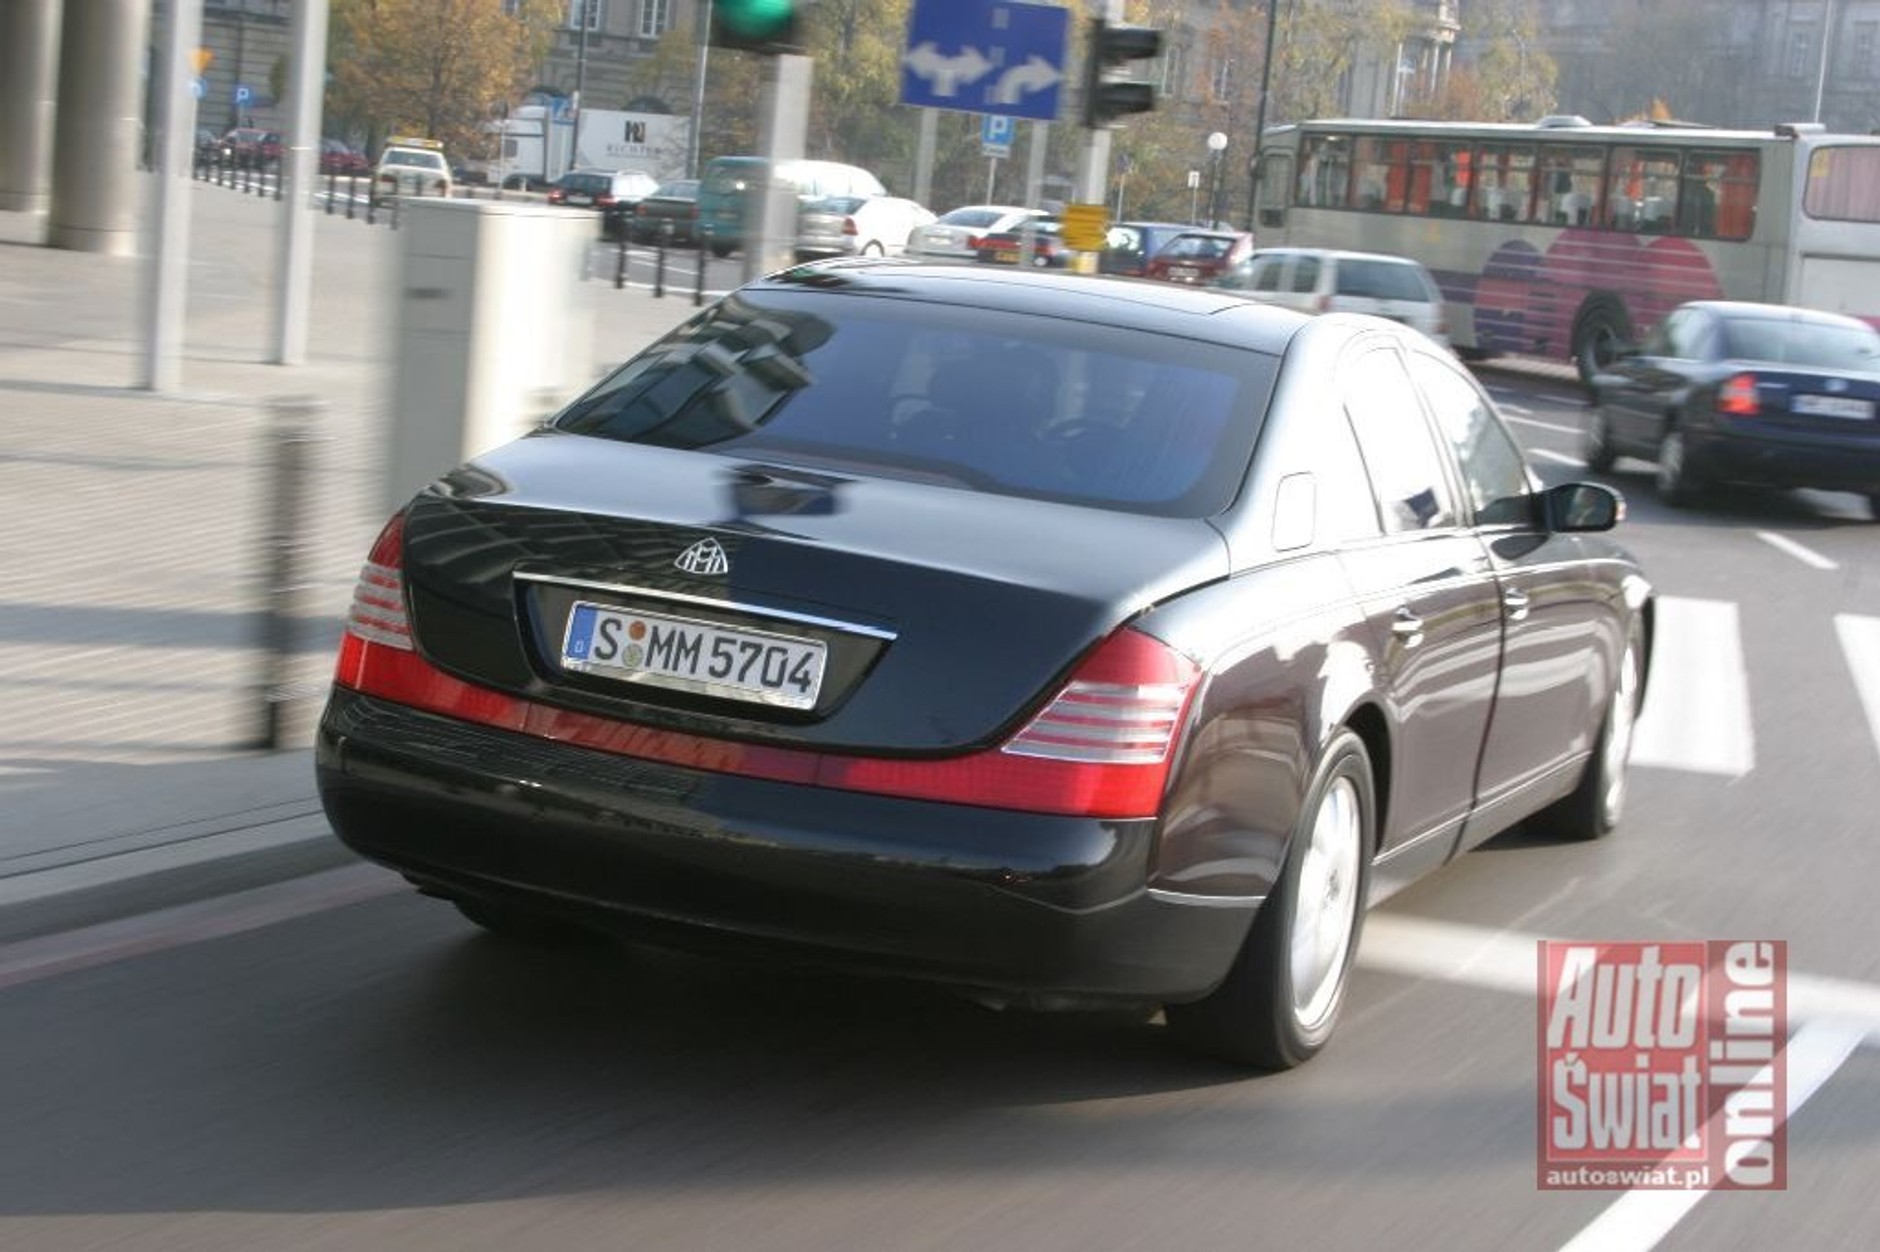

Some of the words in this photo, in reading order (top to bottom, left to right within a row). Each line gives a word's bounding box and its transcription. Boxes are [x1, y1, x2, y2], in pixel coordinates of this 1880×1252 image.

[236, 87, 249, 103] P
[990, 115, 1007, 139] P
[594, 618, 622, 660] S
[644, 626, 703, 675] MM
[708, 636, 815, 693] 5704
